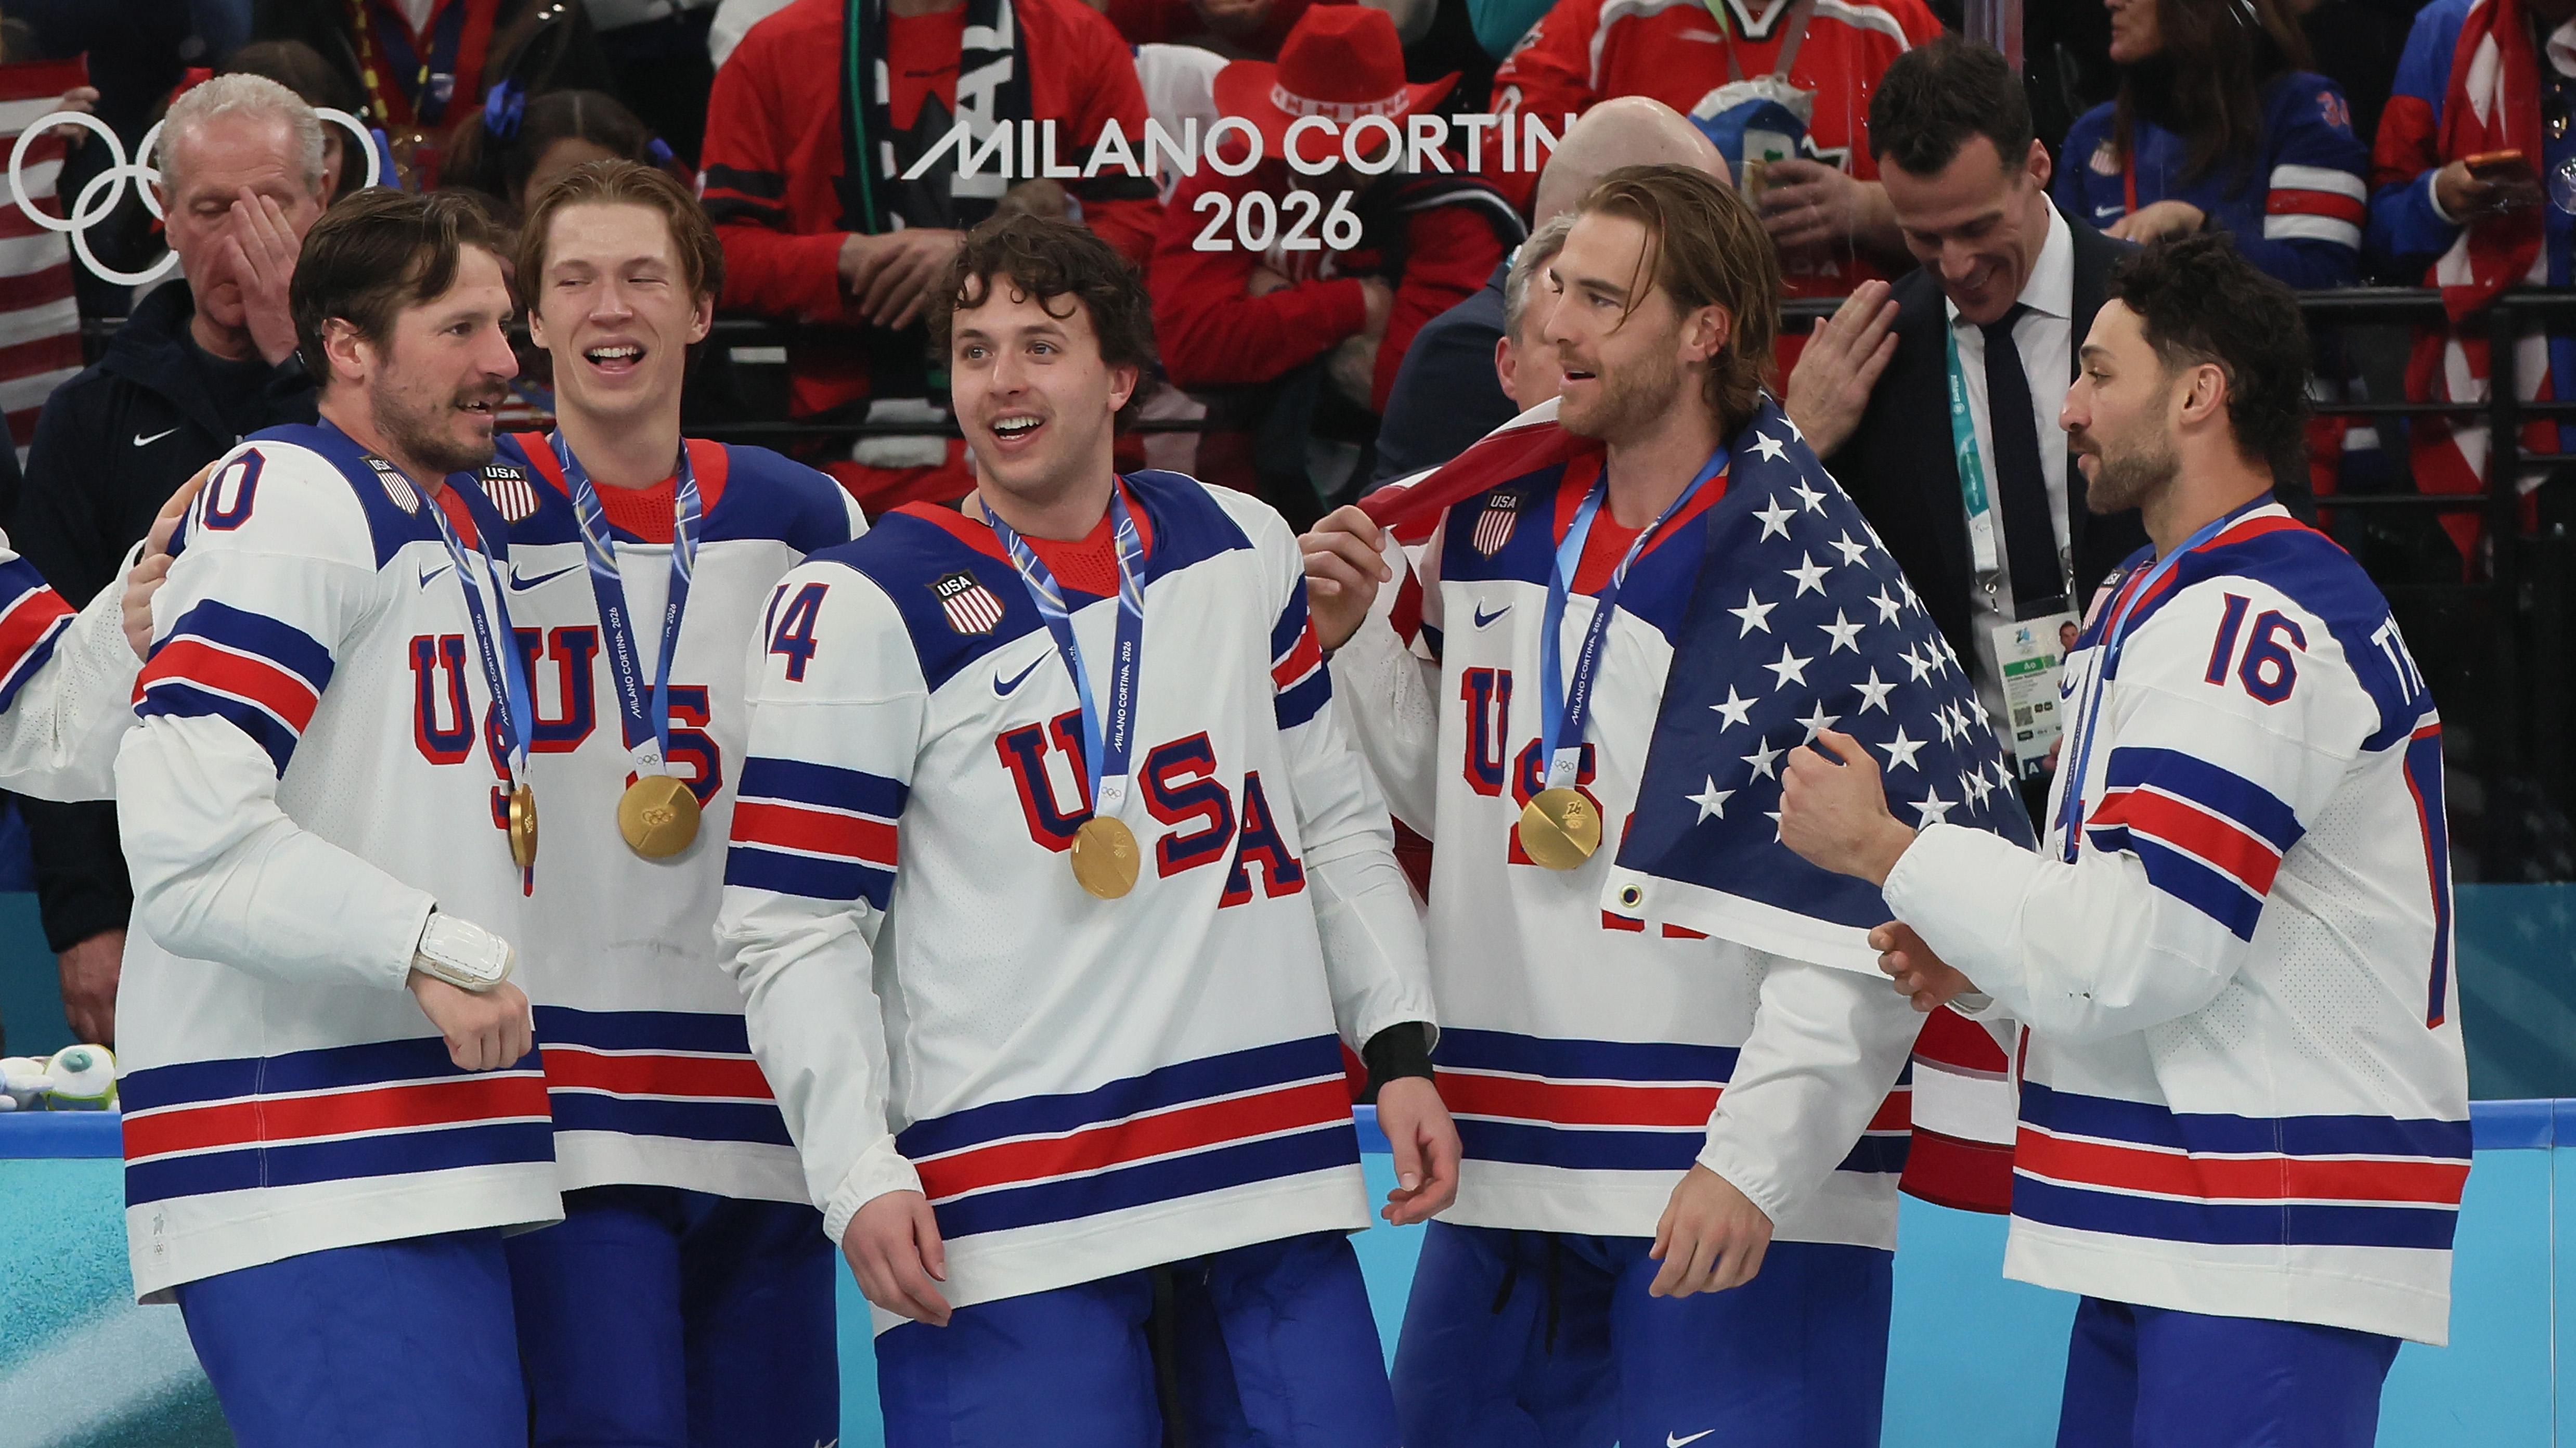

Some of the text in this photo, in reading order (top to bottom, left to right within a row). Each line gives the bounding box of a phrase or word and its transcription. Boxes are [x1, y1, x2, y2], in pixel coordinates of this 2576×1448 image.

[900, 112, 1577, 180] MILANO CORTIN
[1192, 190, 1363, 251] 2026
[196, 446, 267, 536] 0
[369, 459, 393, 471] USA
[485, 467, 520, 479] USA
[1491, 495, 1517, 508] USA
[937, 576, 972, 597] USA
[2103, 573, 2121, 585] USA
[609, 607, 642, 719] MILANO CORTINA 2026
[765, 583, 831, 683] 14
[2204, 591, 2308, 707] 16
[1114, 641, 1132, 753] MILANO CORTINA 2026
[1571, 612, 1604, 726] MILANO CORTINA 2026
[495, 683, 510, 727] MILANO
[2029, 761, 2039, 774] A
[995, 708, 1306, 909] USA
